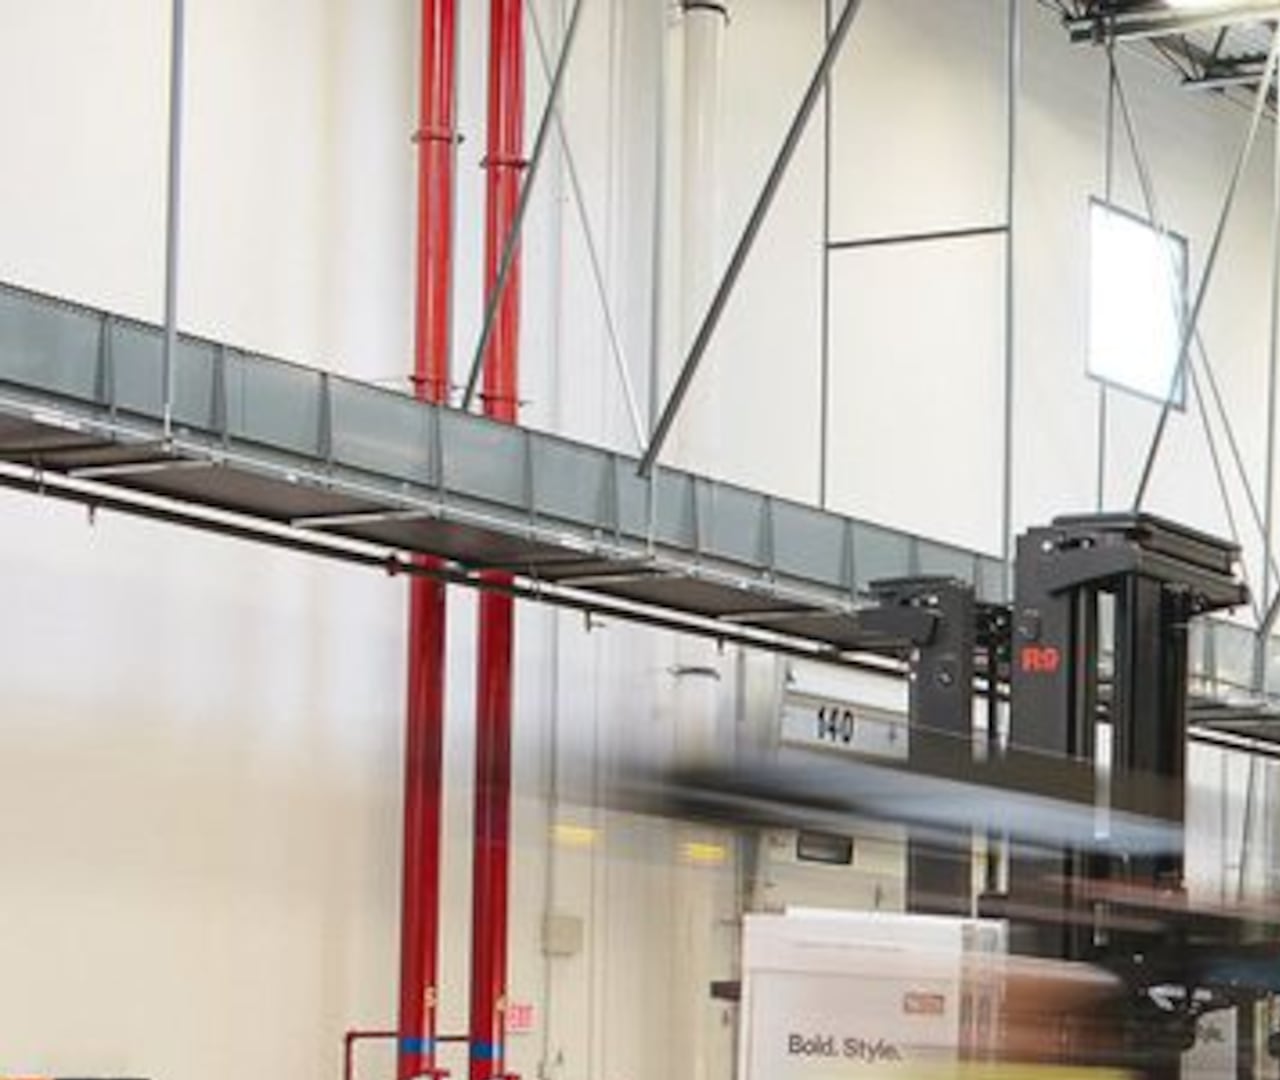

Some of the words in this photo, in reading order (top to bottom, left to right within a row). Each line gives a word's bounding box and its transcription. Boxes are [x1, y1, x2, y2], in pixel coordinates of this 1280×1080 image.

[1021, 647, 1060, 673] R9
[817, 705, 854, 744] 140
[787, 1033, 838, 1057] Bold.
[842, 1037, 902, 1064] Style.
